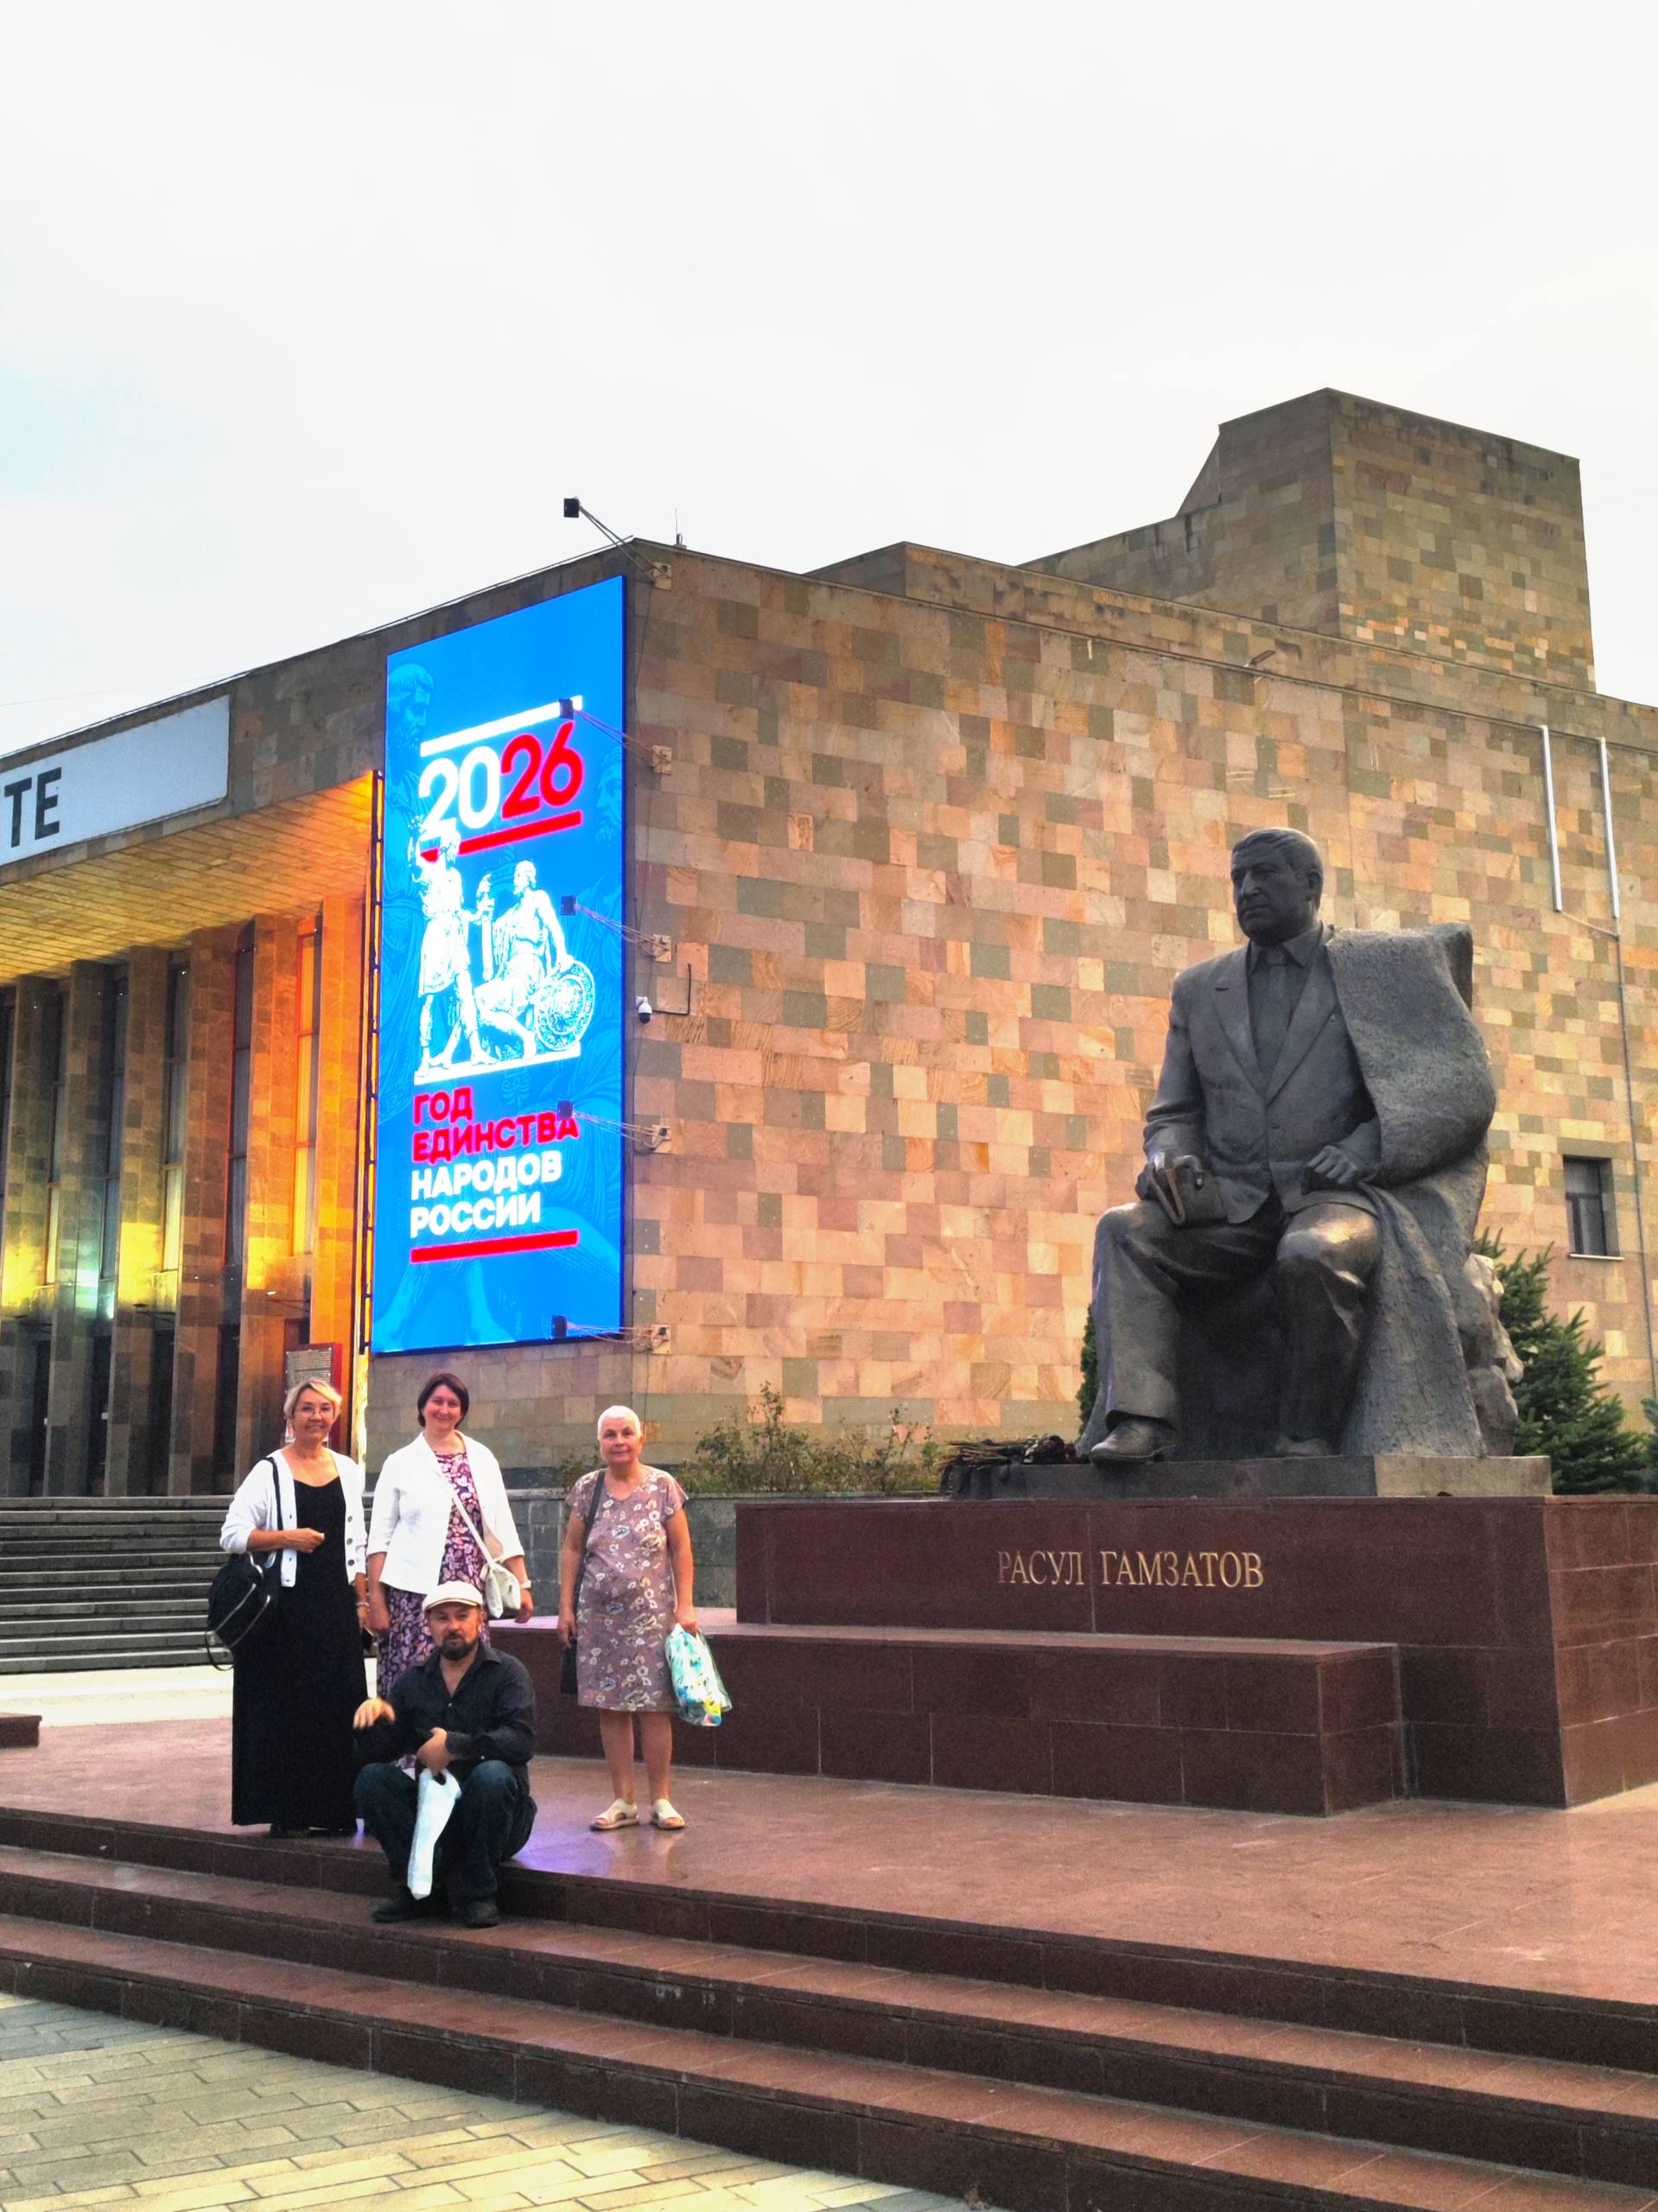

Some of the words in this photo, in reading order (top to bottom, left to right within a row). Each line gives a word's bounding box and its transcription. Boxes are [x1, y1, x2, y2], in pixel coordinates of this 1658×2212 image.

[419, 721, 584, 830] 2026
[413, 1086, 473, 1125] ГОД
[412, 1112, 580, 1164] ЕДИНСТВА
[410, 1150, 562, 1200] НАРОДОВ
[410, 1192, 541, 1237] РОССИИ
[997, 1551, 1085, 1586] РАСУЛ
[1100, 1551, 1265, 1587] ГАМЗАТОВ
